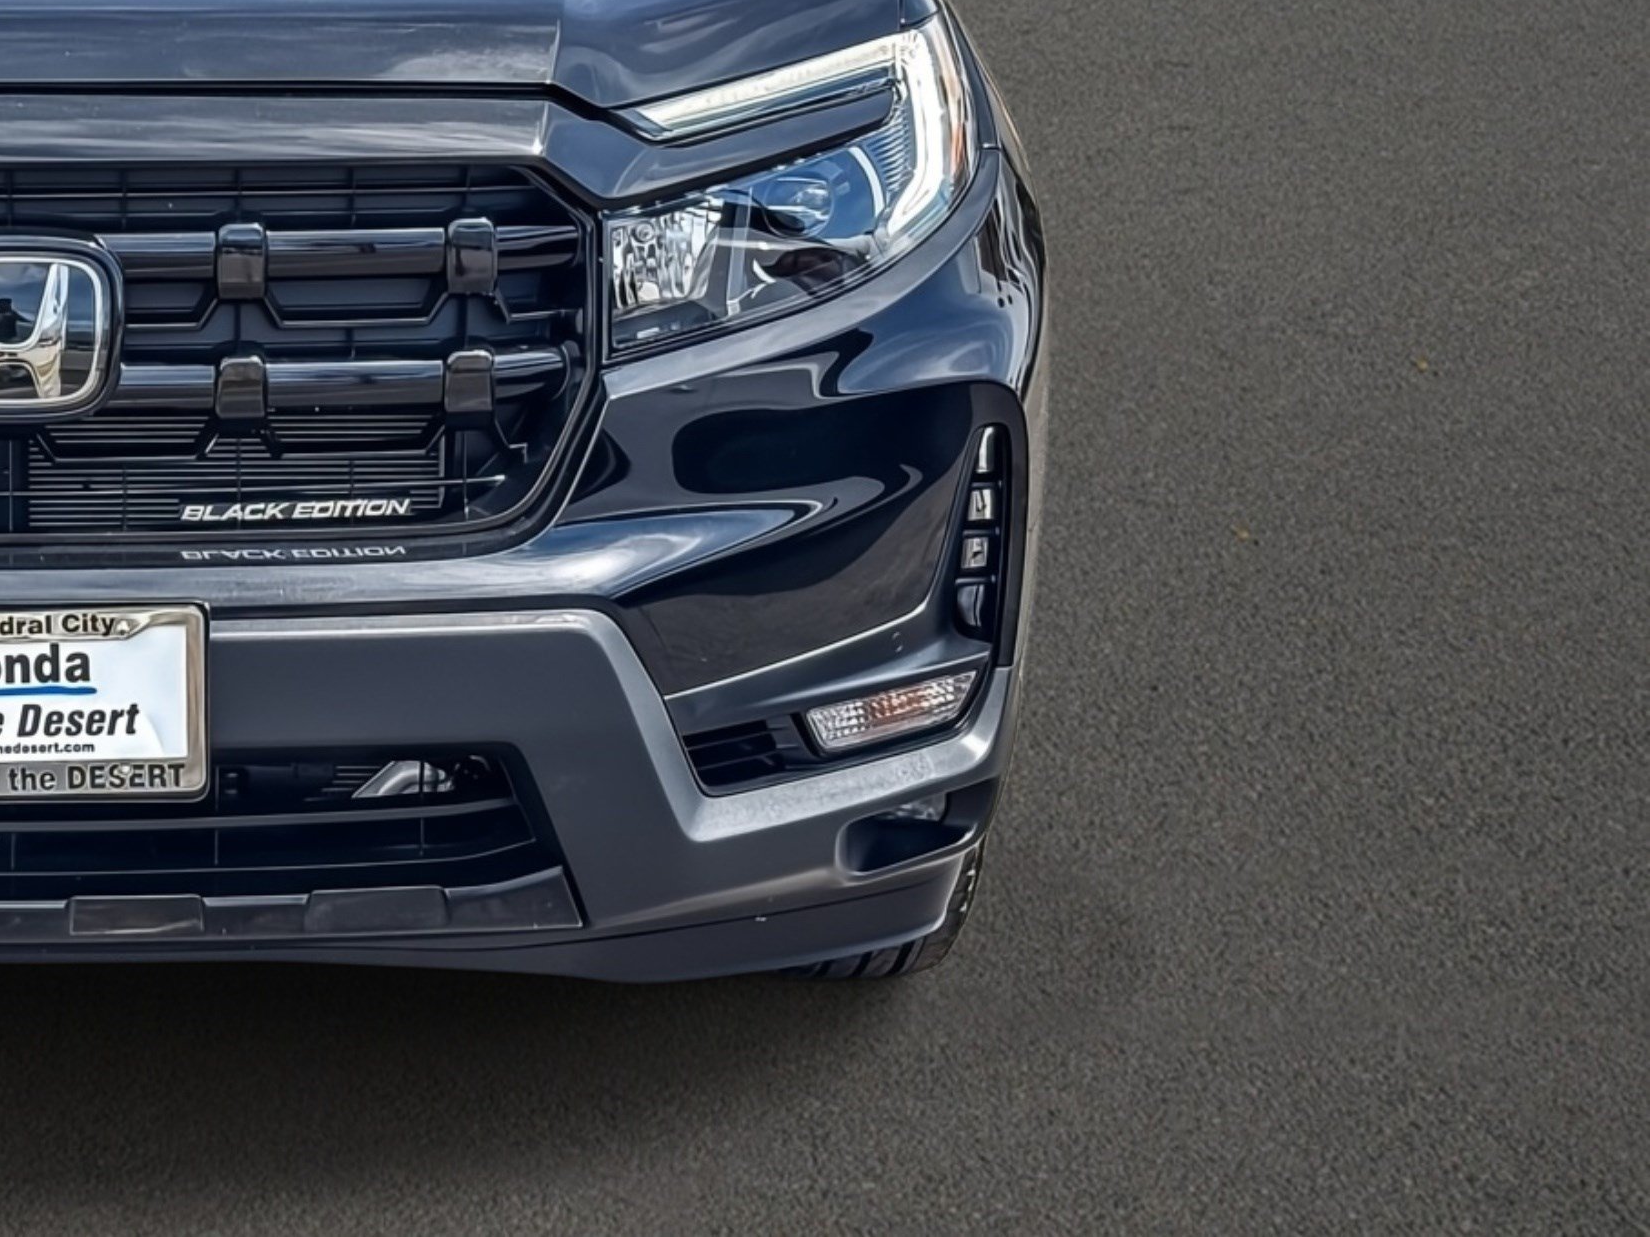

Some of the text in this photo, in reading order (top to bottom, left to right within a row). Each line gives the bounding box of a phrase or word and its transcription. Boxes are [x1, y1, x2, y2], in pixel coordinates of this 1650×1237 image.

[181, 499, 410, 522] BLACK EDITION
[61, 614, 116, 638] City
[17, 703, 140, 738] Desert
[8, 766, 56, 790] the
[67, 763, 186, 790] DESERT
